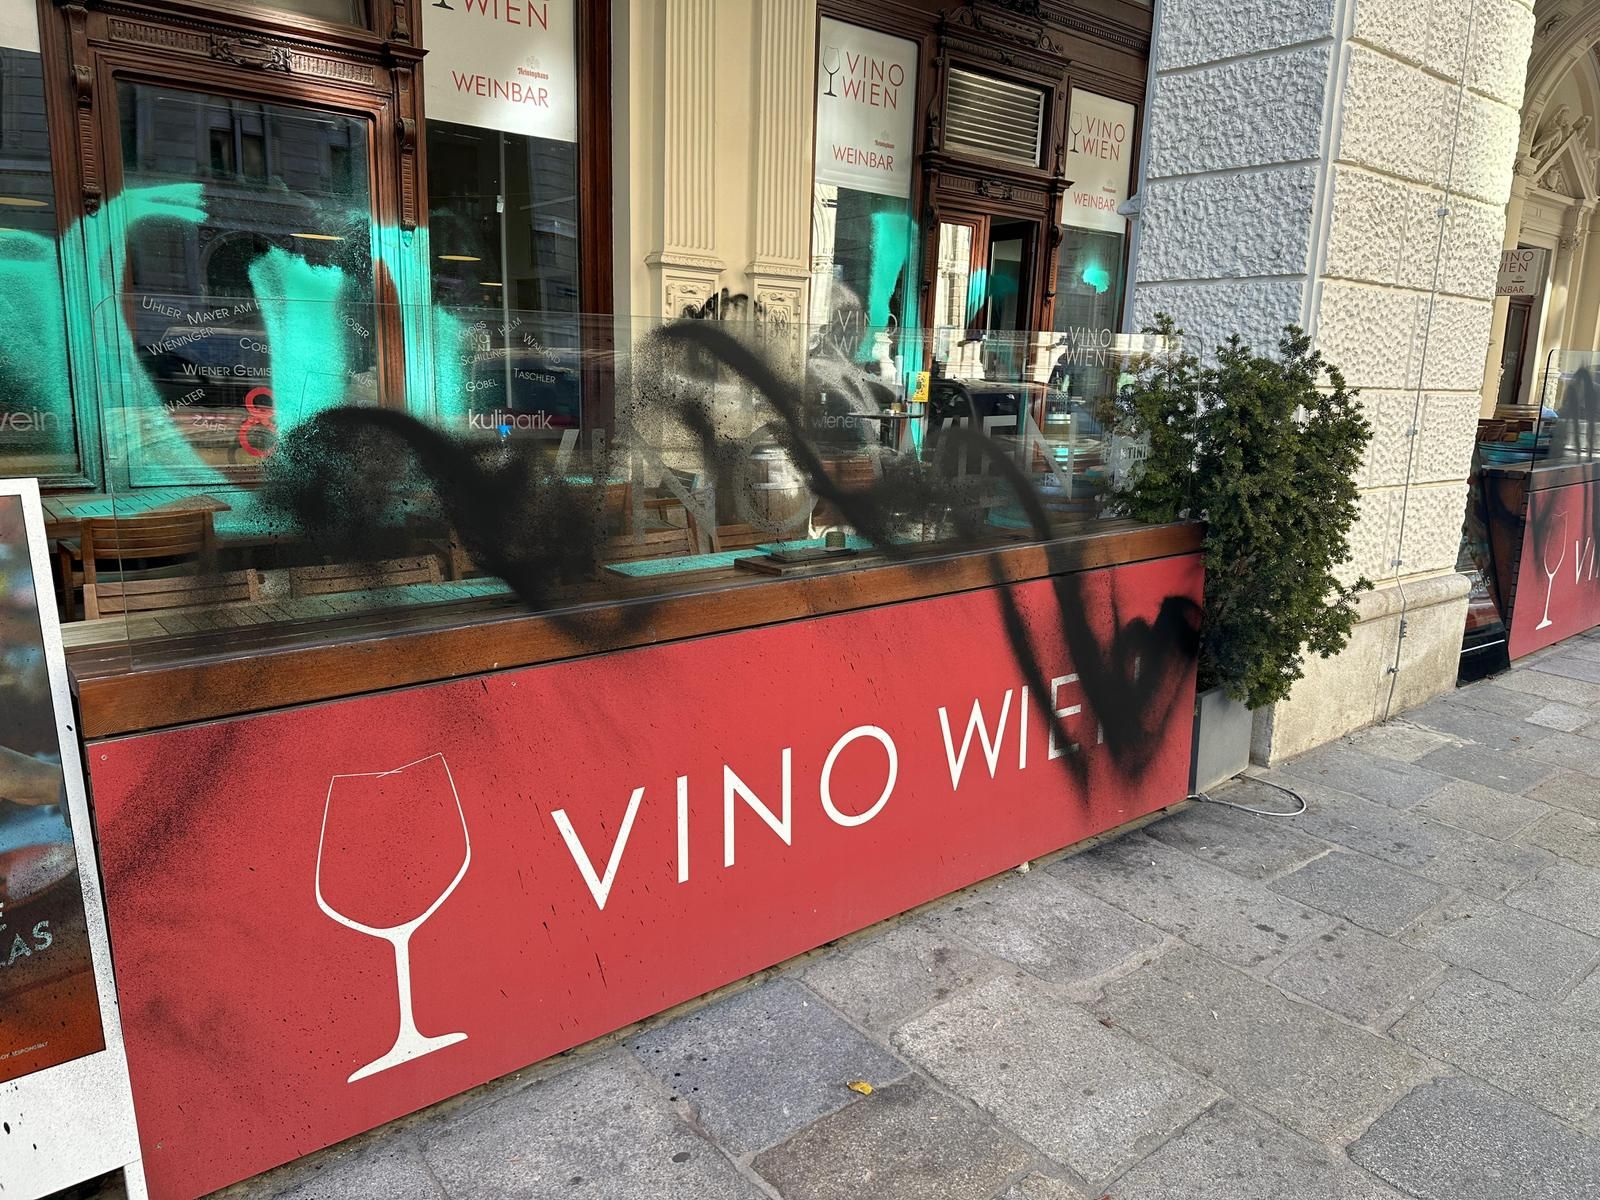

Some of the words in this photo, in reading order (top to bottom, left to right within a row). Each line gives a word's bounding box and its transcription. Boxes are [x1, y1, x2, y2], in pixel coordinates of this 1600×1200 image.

[846, 51, 904, 87] VINO
[452, 70, 549, 108] WEINBAR
[842, 75, 897, 110] WIEN
[1086, 115, 1125, 142] VINO
[833, 144, 894, 172] WEINBAR
[1082, 135, 1120, 161] WIEN
[1073, 192, 1116, 212] WEINBAR
[1501, 251, 1534, 262] INO
[1496, 285, 1525, 294] INBAR
[142, 295, 182, 319] UHLER
[187, 307, 230, 325] MAYER
[233, 302, 252, 315] AM
[146, 326, 215, 356] WIENINGER
[1069, 326, 1112, 348] VINO
[1065, 346, 1107, 367] WIEN
[182, 363, 230, 377] WIENER
[233, 364, 273, 377] GEMIS
[513, 367, 556, 384] TASCHLER
[468, 409, 553, 430] kulinarik
[551, 723, 898, 911] VINO
[938, 655, 1141, 791] WIE
